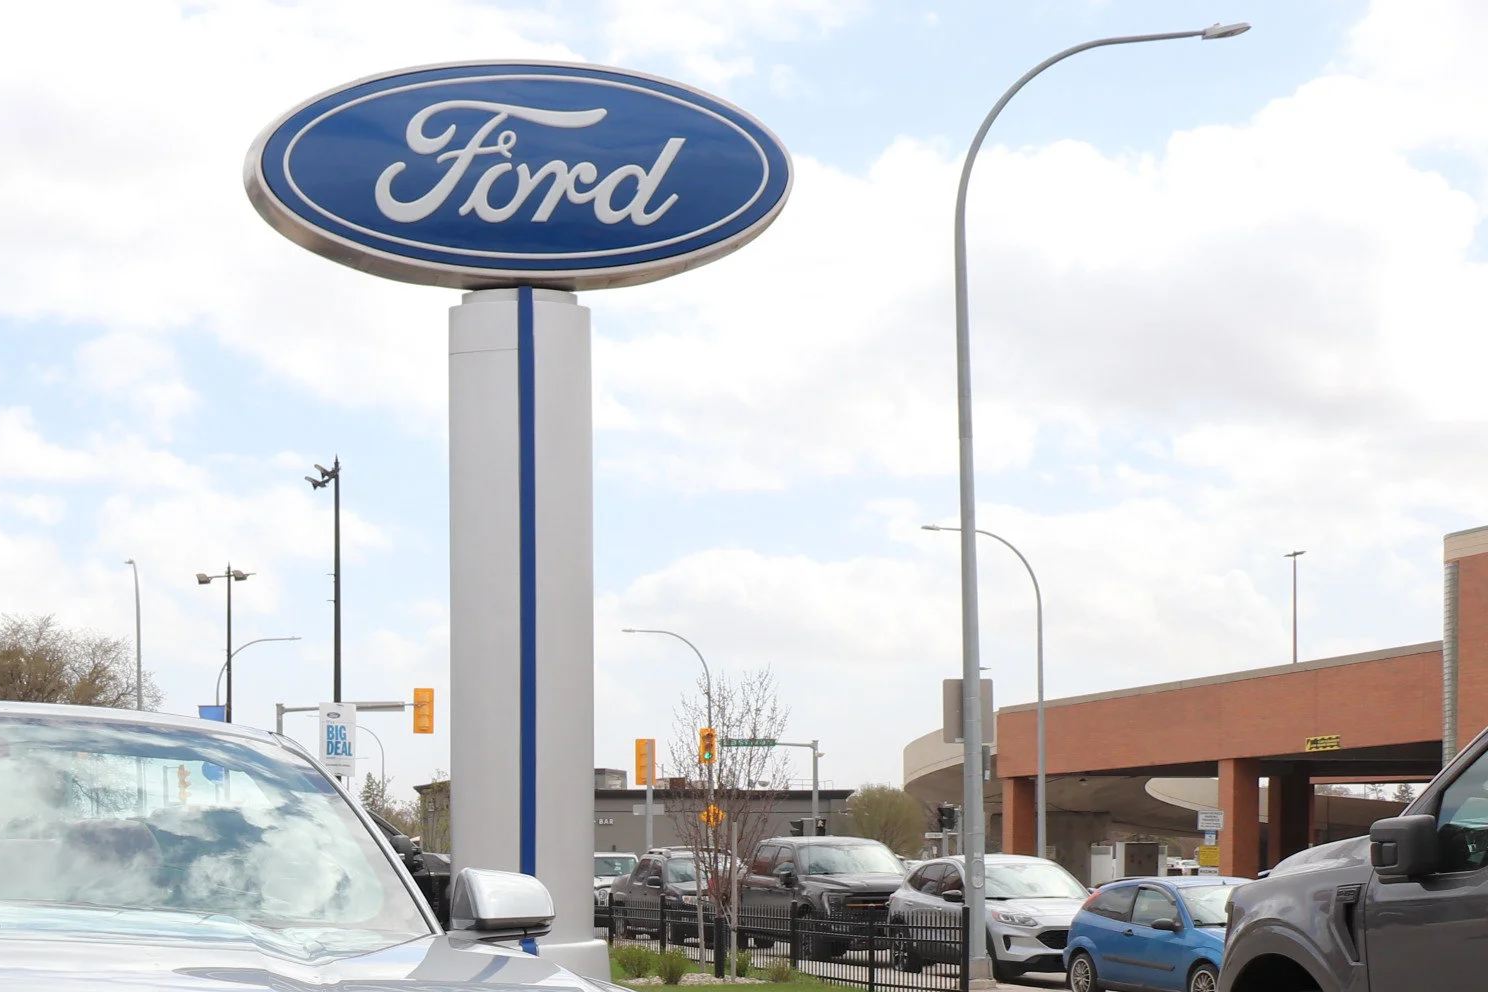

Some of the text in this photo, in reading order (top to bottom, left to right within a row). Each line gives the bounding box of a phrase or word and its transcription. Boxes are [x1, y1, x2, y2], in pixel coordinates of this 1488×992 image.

[374, 100, 686, 226] Ford
[326, 725, 346, 740] BIG
[326, 741, 352, 756] DEAL
